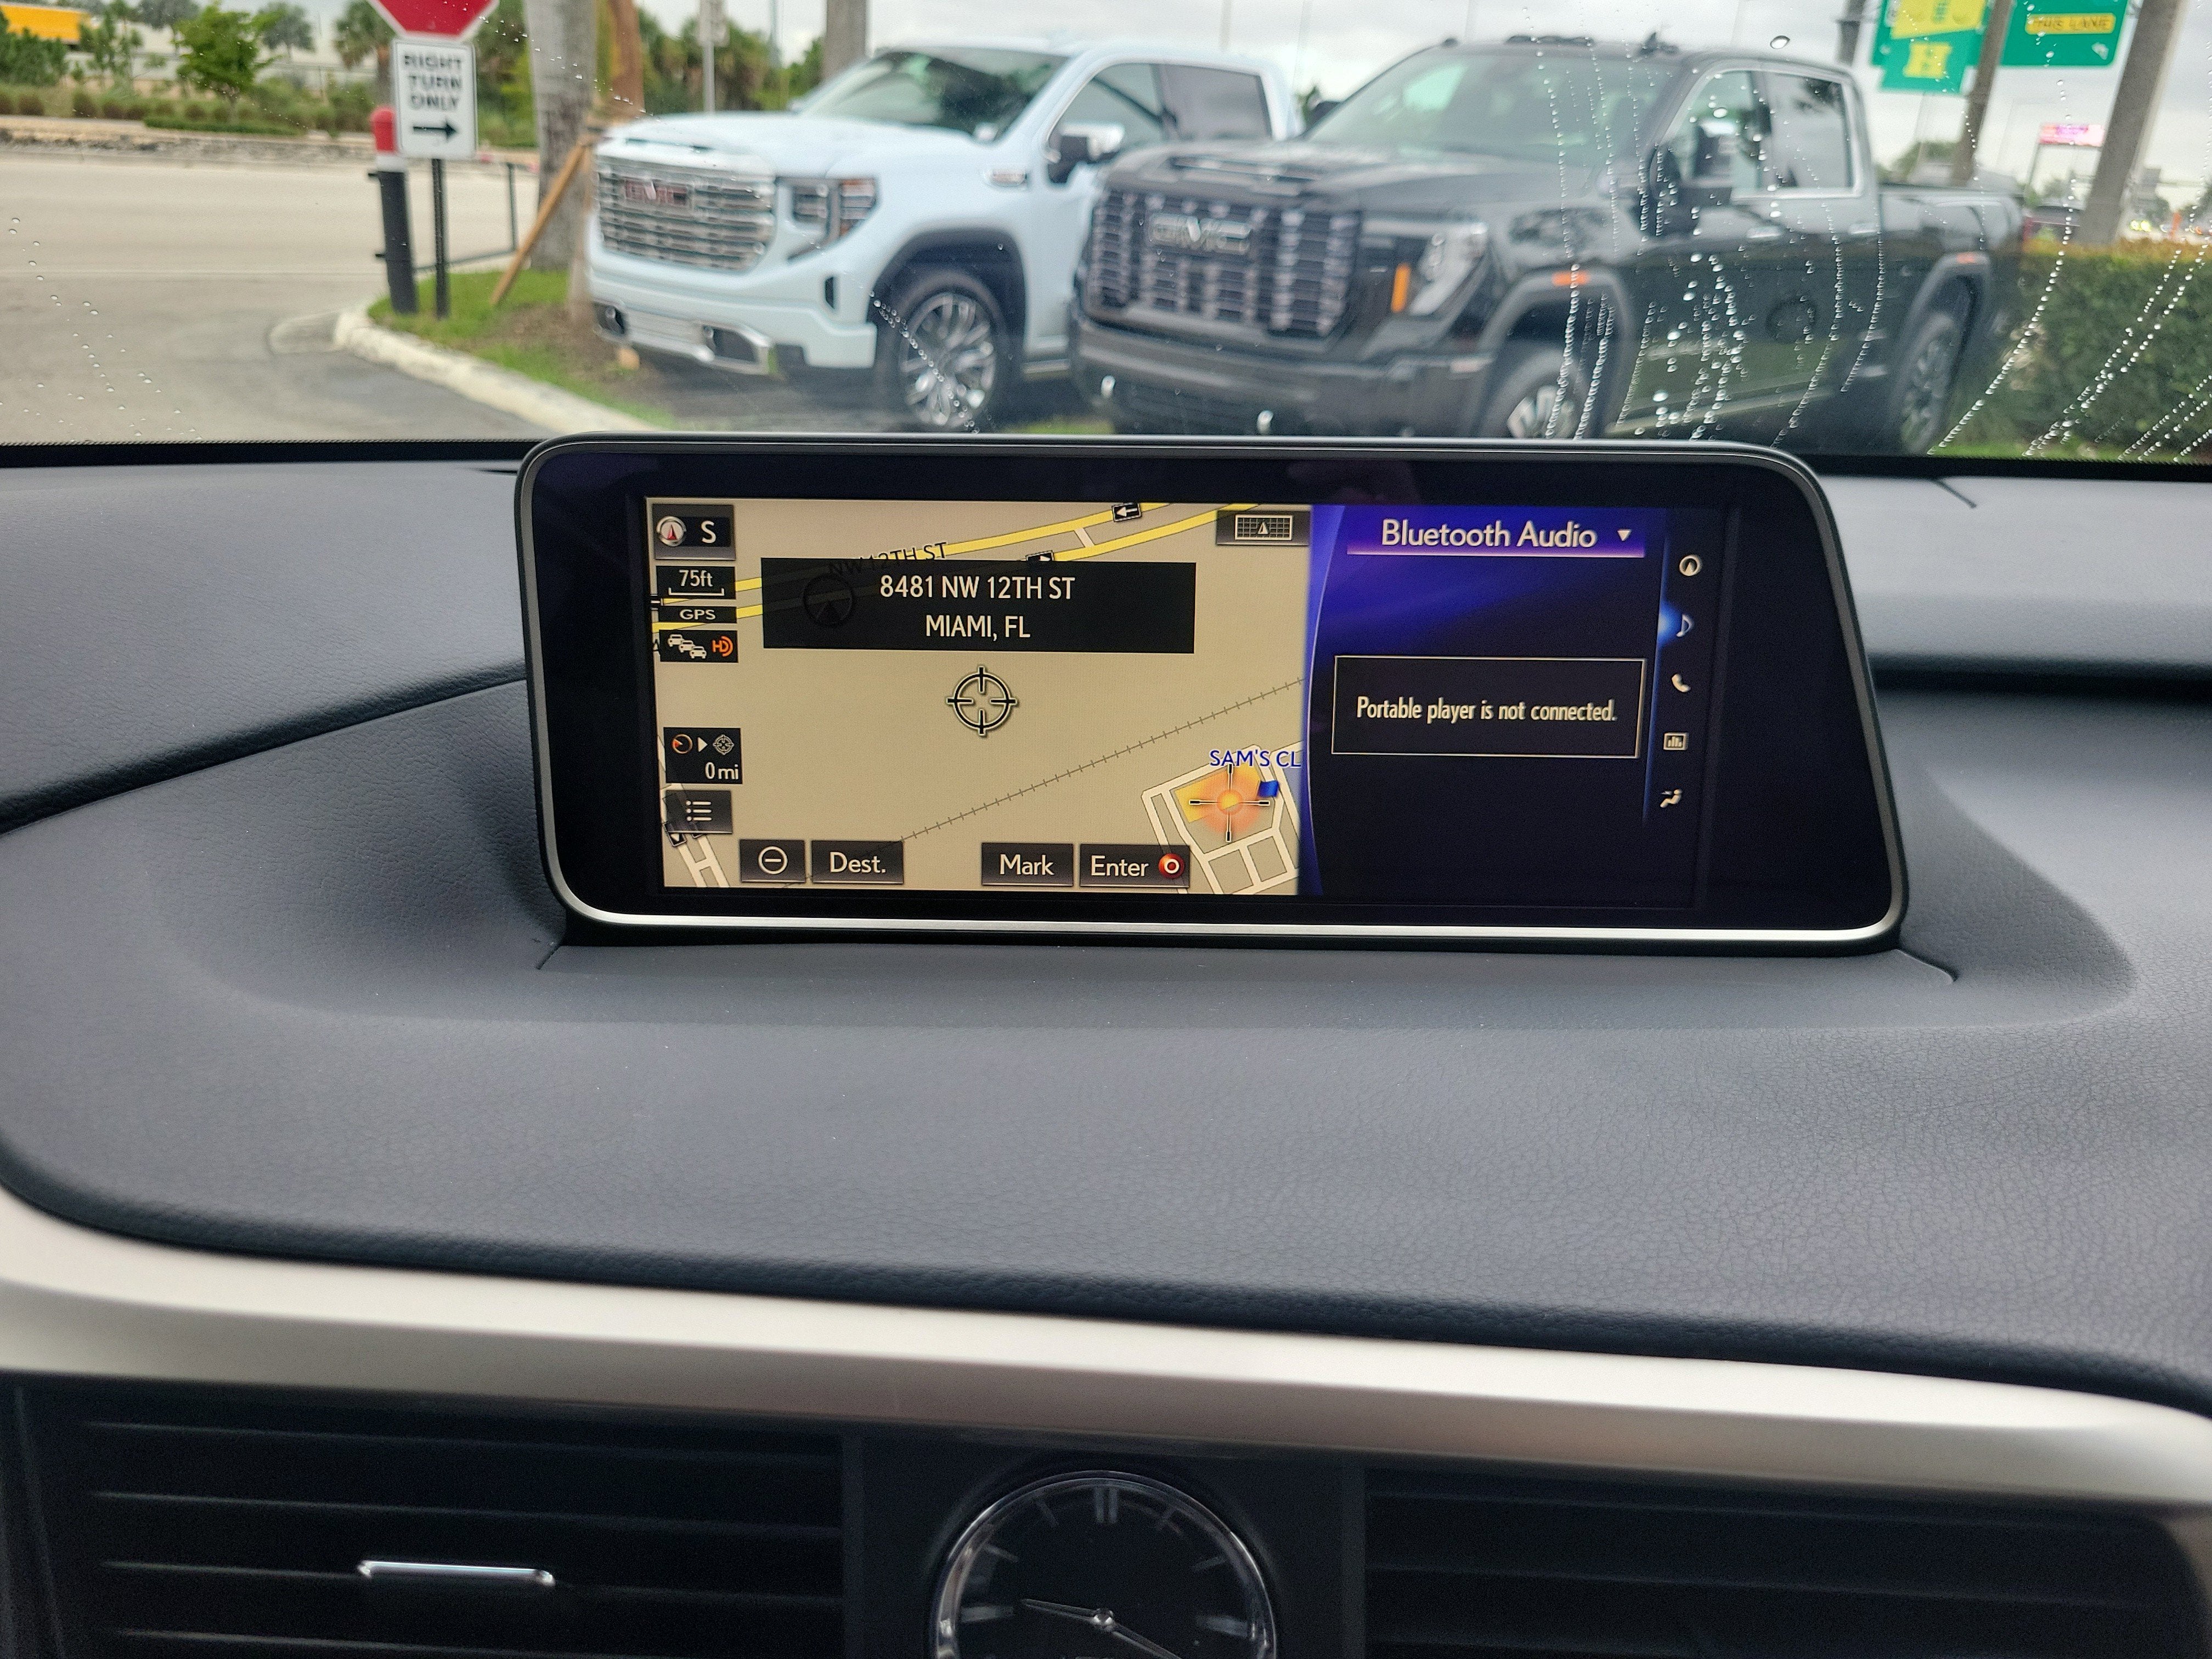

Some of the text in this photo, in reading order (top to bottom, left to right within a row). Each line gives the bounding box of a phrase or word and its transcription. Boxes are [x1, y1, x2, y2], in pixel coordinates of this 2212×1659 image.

[404, 54, 462, 68] RIGHT
[409, 74, 461, 89] TURN
[411, 94, 459, 110] ONLY
[701, 521, 716, 544] S
[1381, 518, 1597, 548] Bluetooth Audio
[923, 541, 946, 560] ST
[679, 569, 713, 588] 75ft
[879, 575, 1075, 600] 8481 NW 12TH ST
[679, 608, 716, 620] GPS
[926, 614, 1031, 641] MIAMI, FL
[1357, 696, 1617, 724] Portable player is not connected.
[1209, 749, 1301, 768] SAM'S CL
[705, 762, 739, 780] 0 mi
[828, 851, 887, 873] Dest.
[998, 854, 1149, 877] Mark Enter
